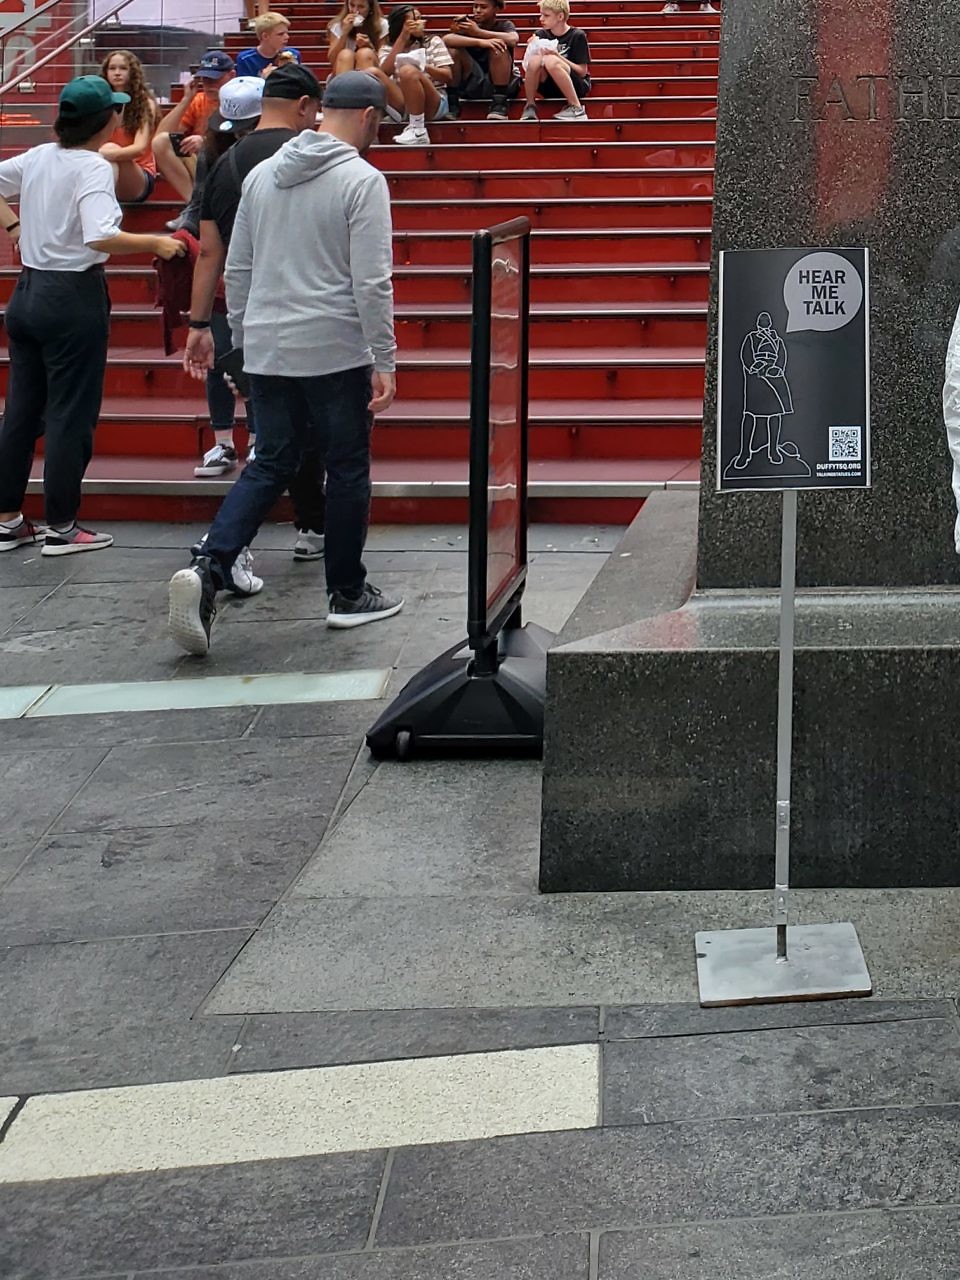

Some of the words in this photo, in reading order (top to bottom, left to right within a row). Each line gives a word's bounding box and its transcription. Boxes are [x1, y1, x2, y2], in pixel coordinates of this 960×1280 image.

[799, 270, 846, 284] HEAR
[812, 286, 838, 299] ME
[803, 301, 846, 315] TALK
